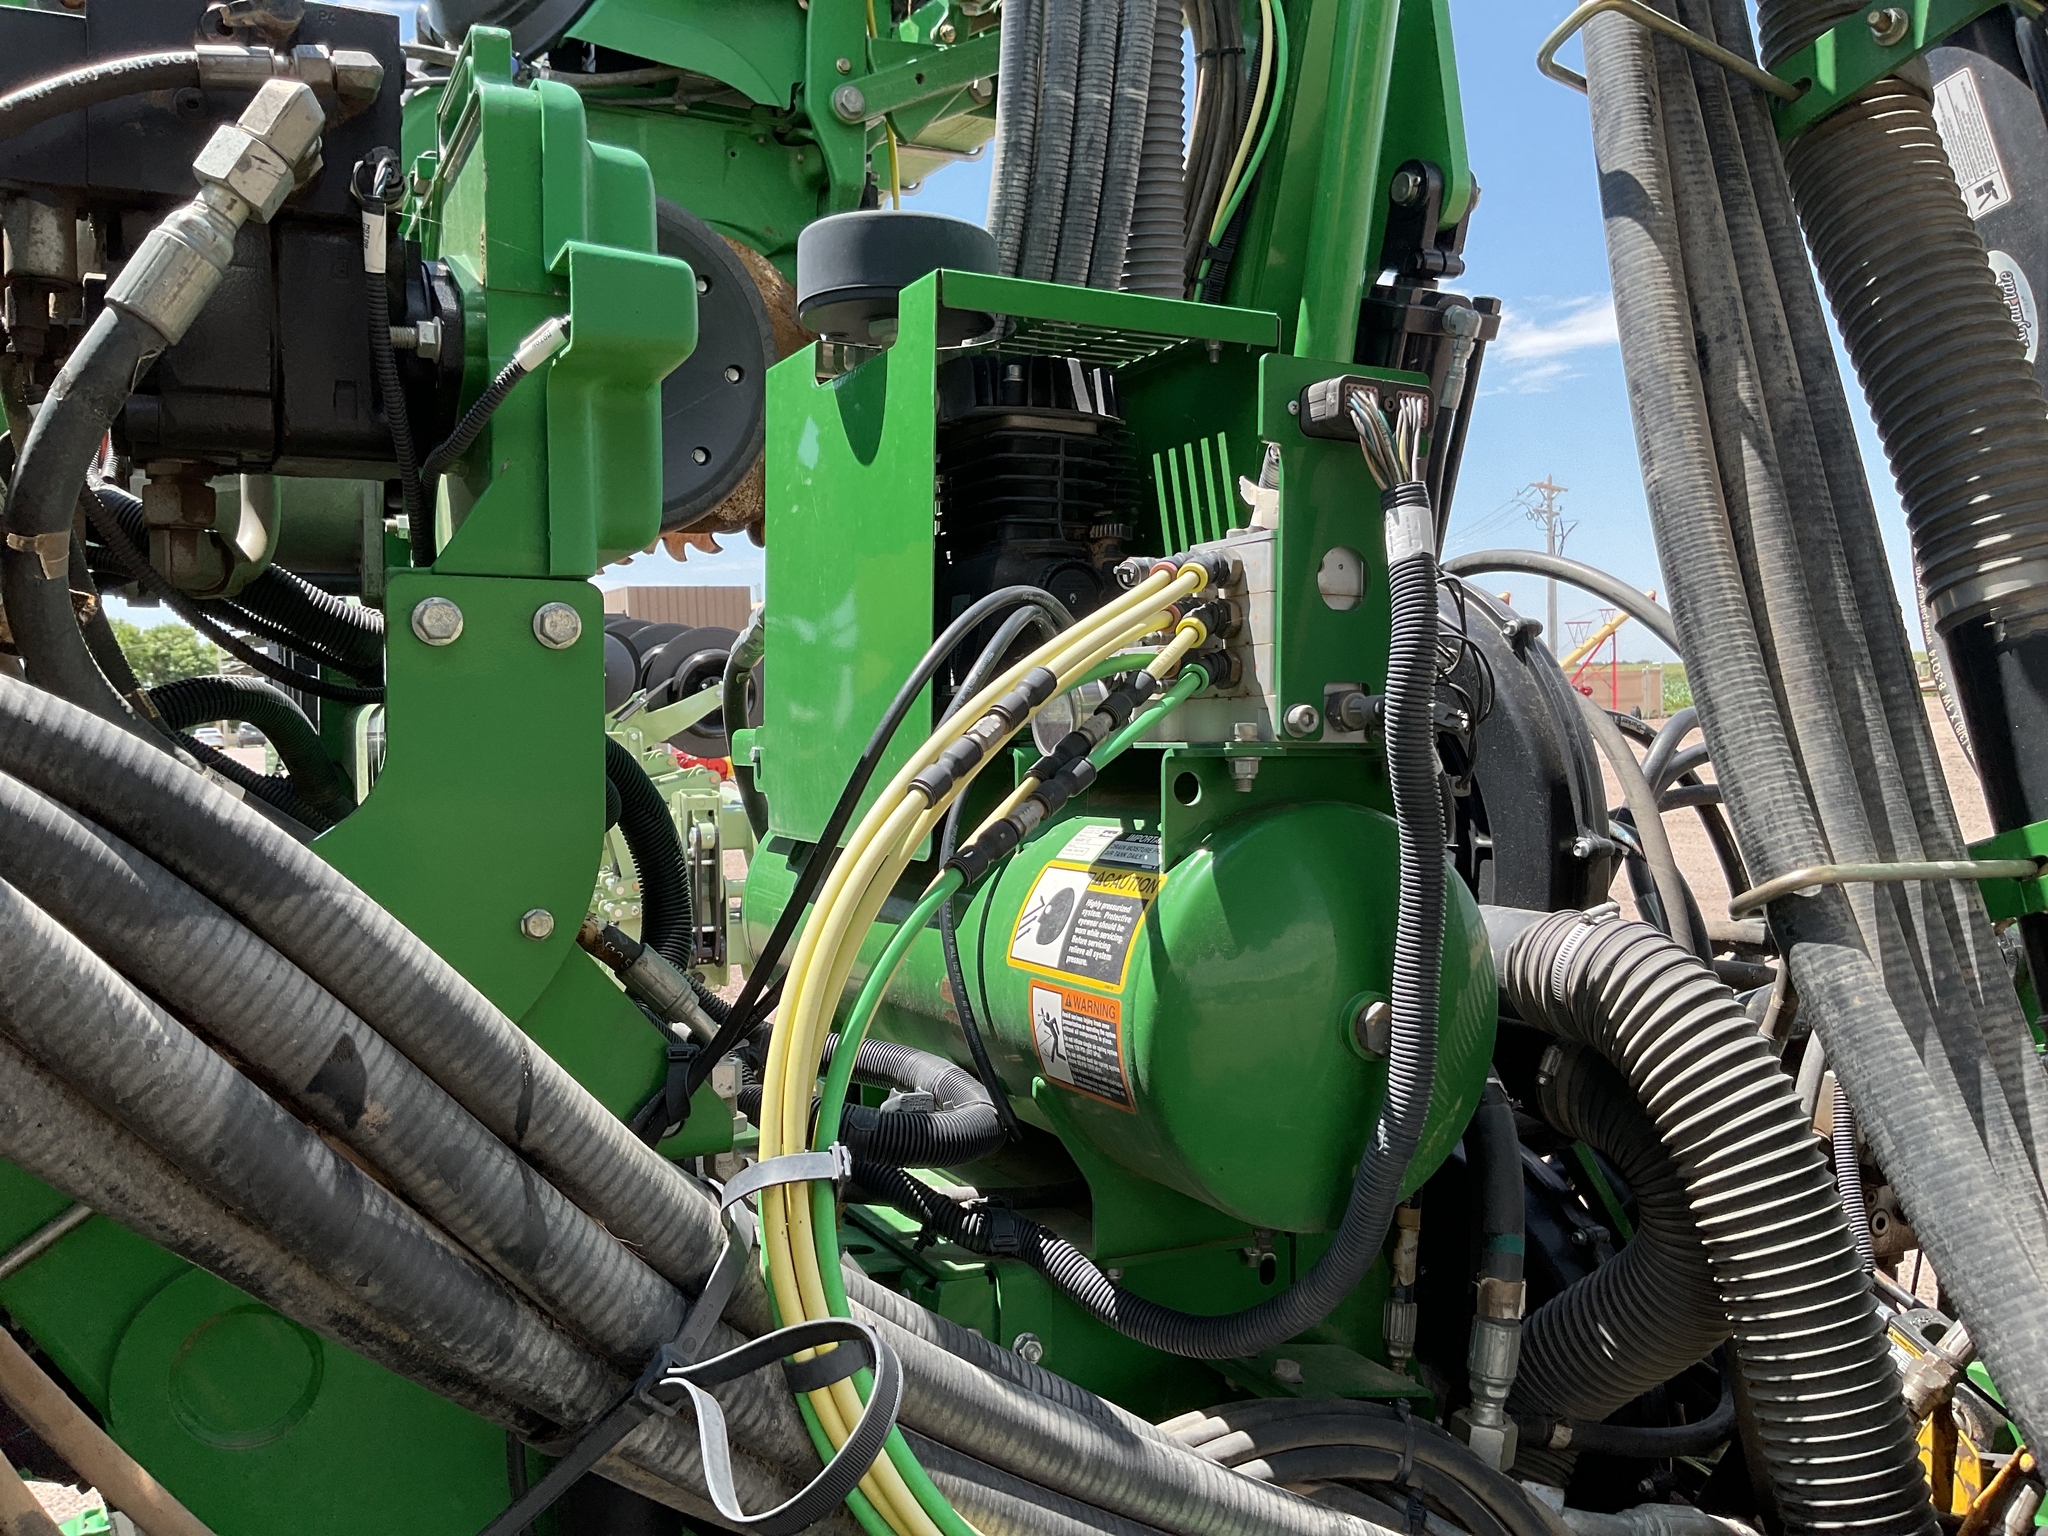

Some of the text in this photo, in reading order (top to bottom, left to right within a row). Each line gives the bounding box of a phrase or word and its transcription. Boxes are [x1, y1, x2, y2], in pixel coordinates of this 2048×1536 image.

[1914, 565, 1933, 645] www.parker.com
[1126, 834, 1161, 844] IMPORTA
[1101, 872, 1161, 894] CAUTION
[1086, 898, 1132, 913] Highly pressurized
[1081, 908, 1132, 924] system. Protective
[1074, 927, 1087, 935] worn
[1086, 928, 1099, 938] while
[1077, 917, 1125, 932] eyewear should be
[1071, 935, 1111, 952] Before servicing
[1065, 955, 1088, 966] pressure.
[1068, 945, 1112, 961] relieve all system
[1073, 995, 1116, 1020] WARNING
